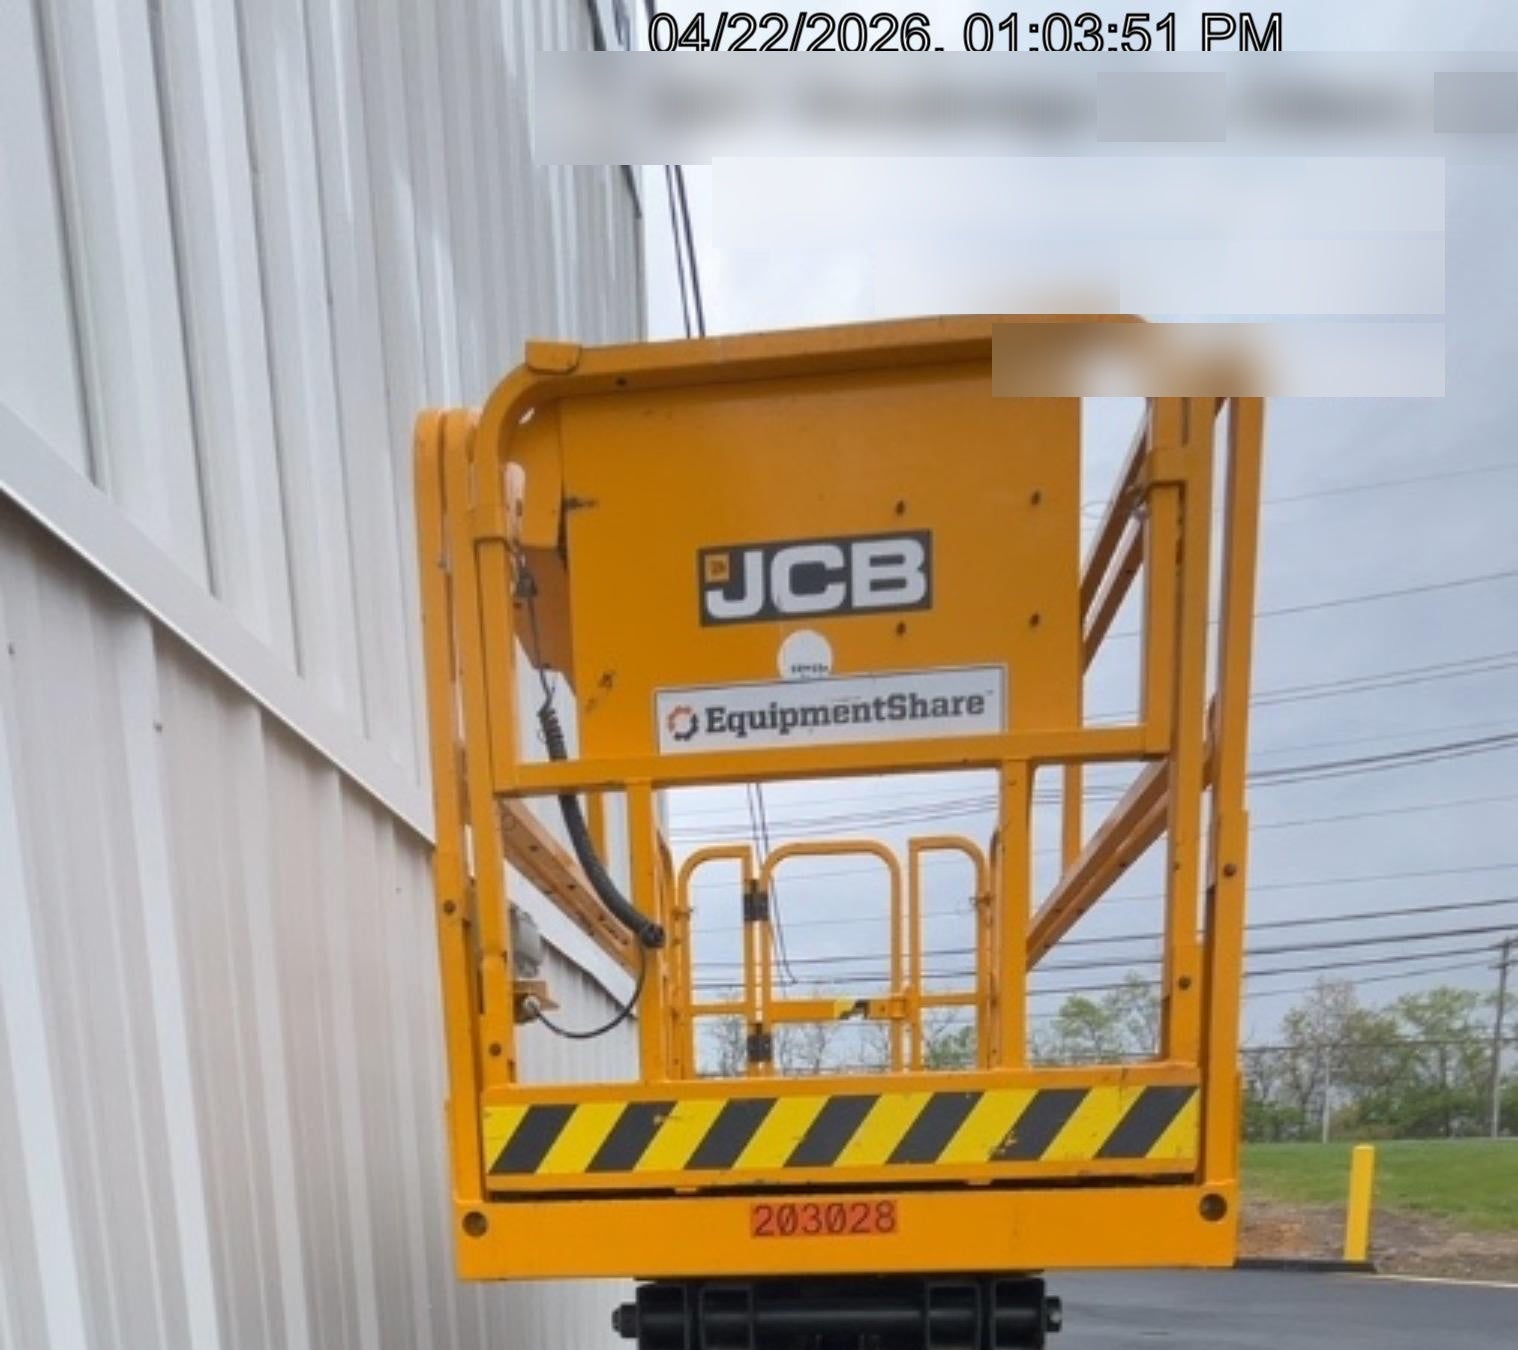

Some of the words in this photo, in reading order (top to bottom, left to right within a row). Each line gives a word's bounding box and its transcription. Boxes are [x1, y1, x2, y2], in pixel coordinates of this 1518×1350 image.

[704, 538, 927, 619] JCB
[705, 693, 985, 738] EquipmentShare
[754, 1200, 896, 1237] 203028
